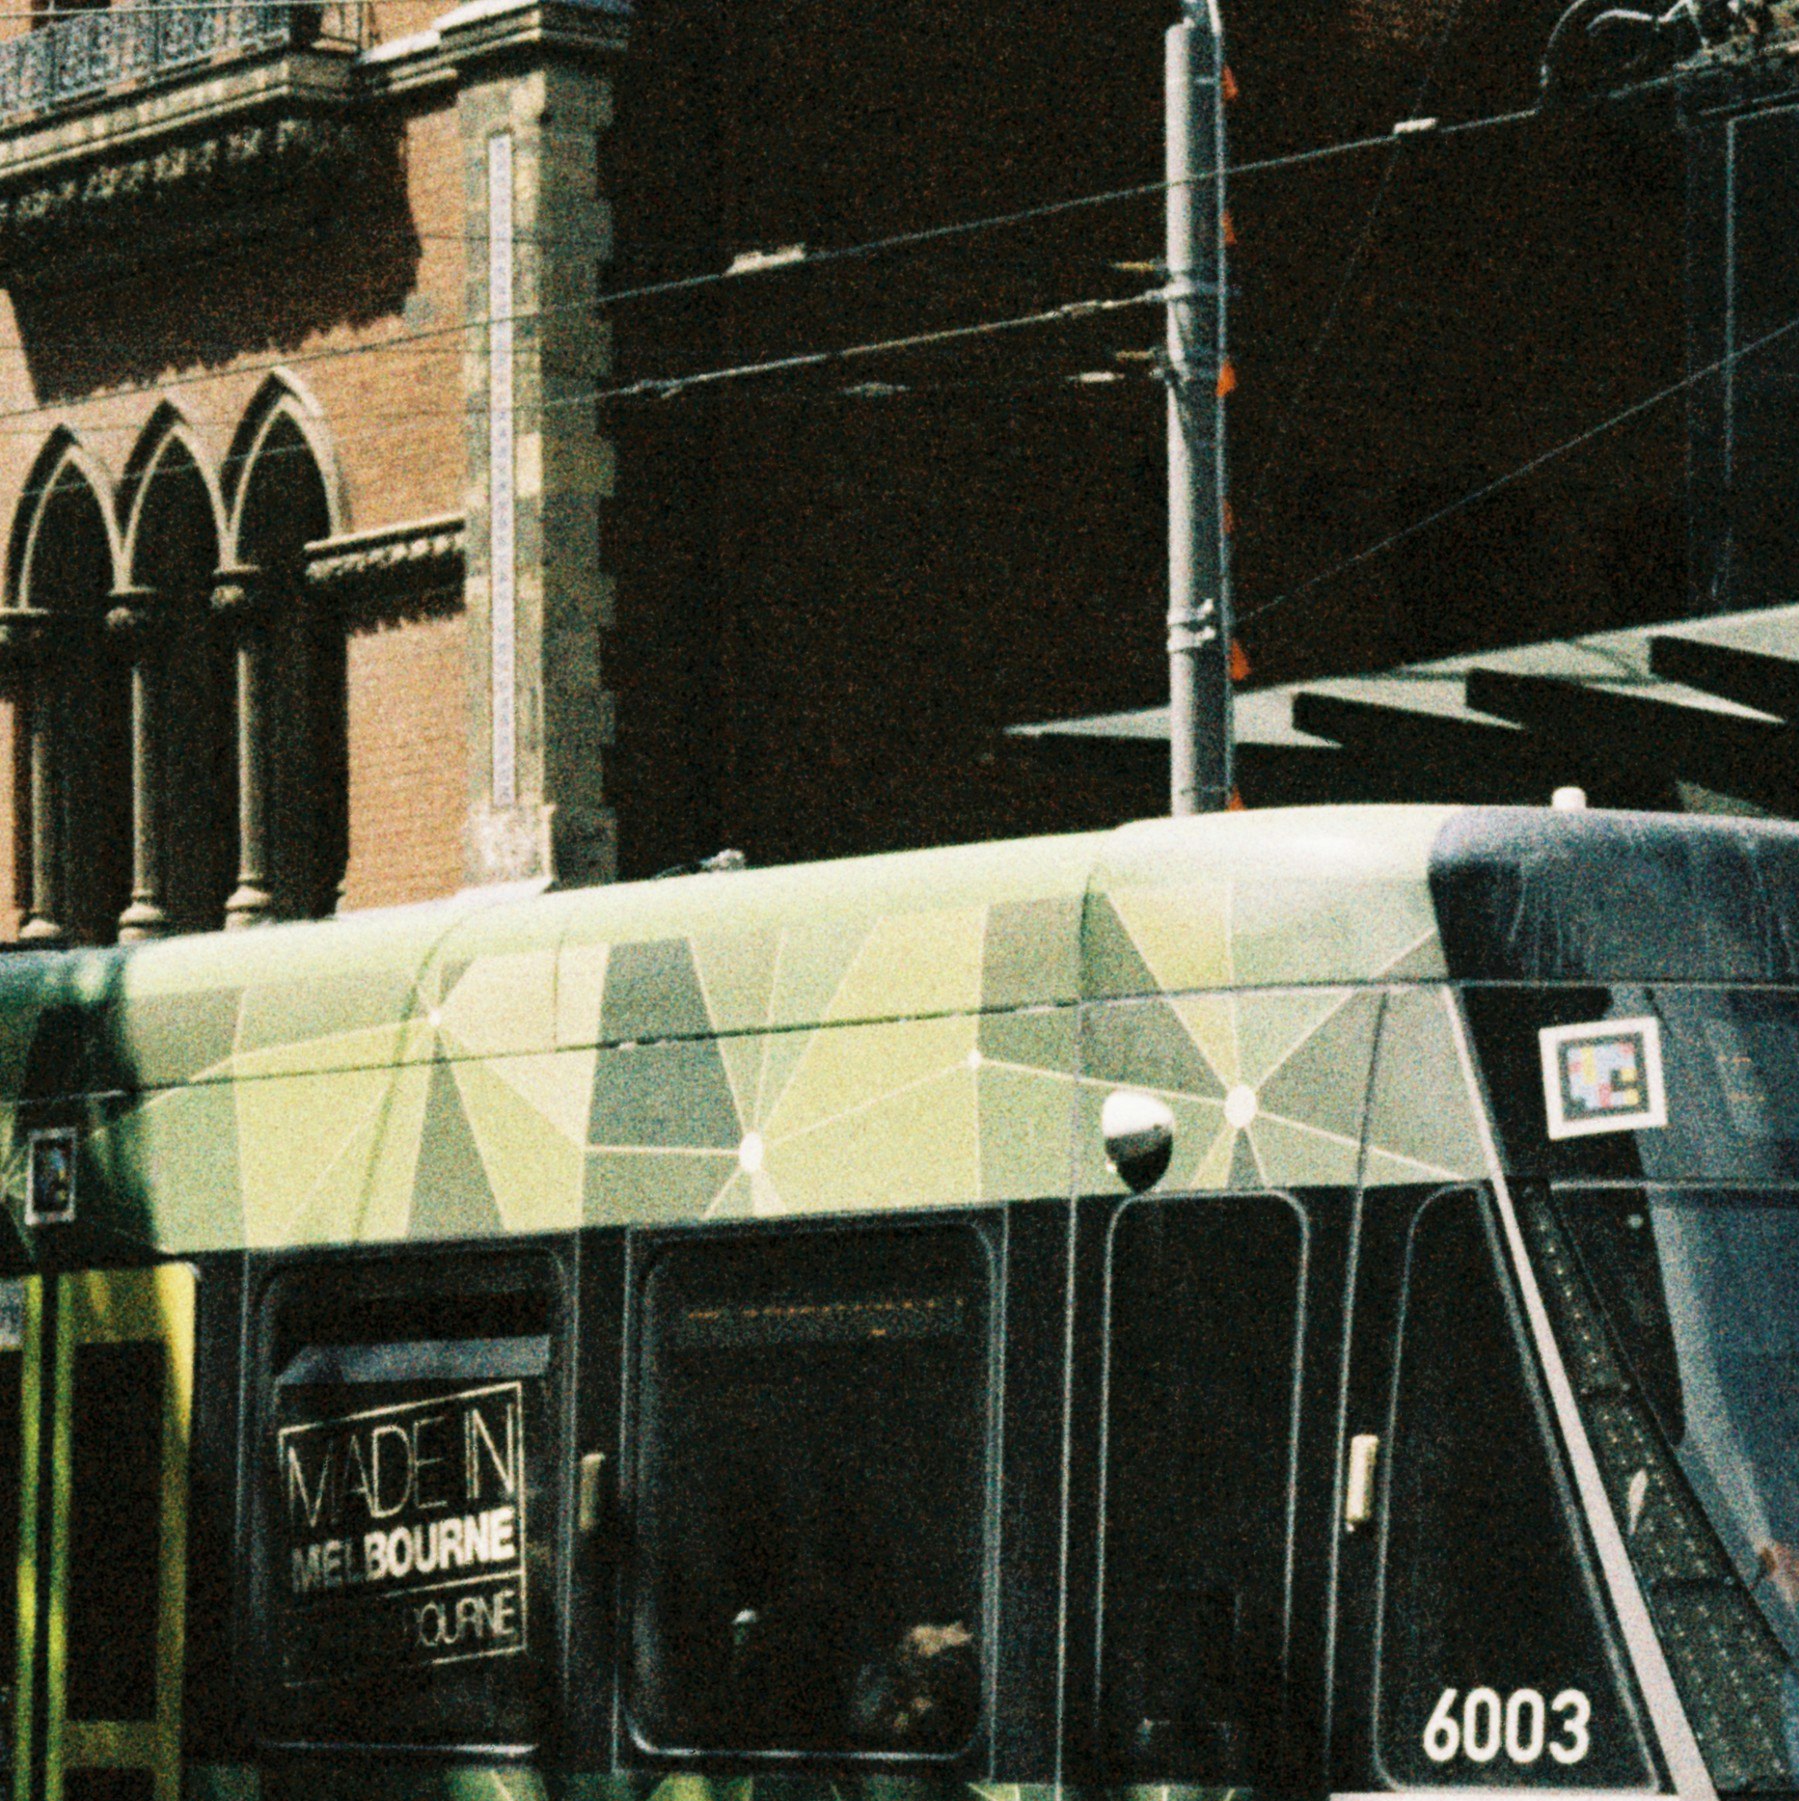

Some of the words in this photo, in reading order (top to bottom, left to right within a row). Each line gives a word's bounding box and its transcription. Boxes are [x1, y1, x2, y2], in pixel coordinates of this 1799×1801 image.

[287, 1415, 448, 1528] MADE
[464, 1403, 516, 1500] IN
[291, 1505, 516, 1595] MELBOURNE
[1422, 1686, 1592, 1765] 6003
